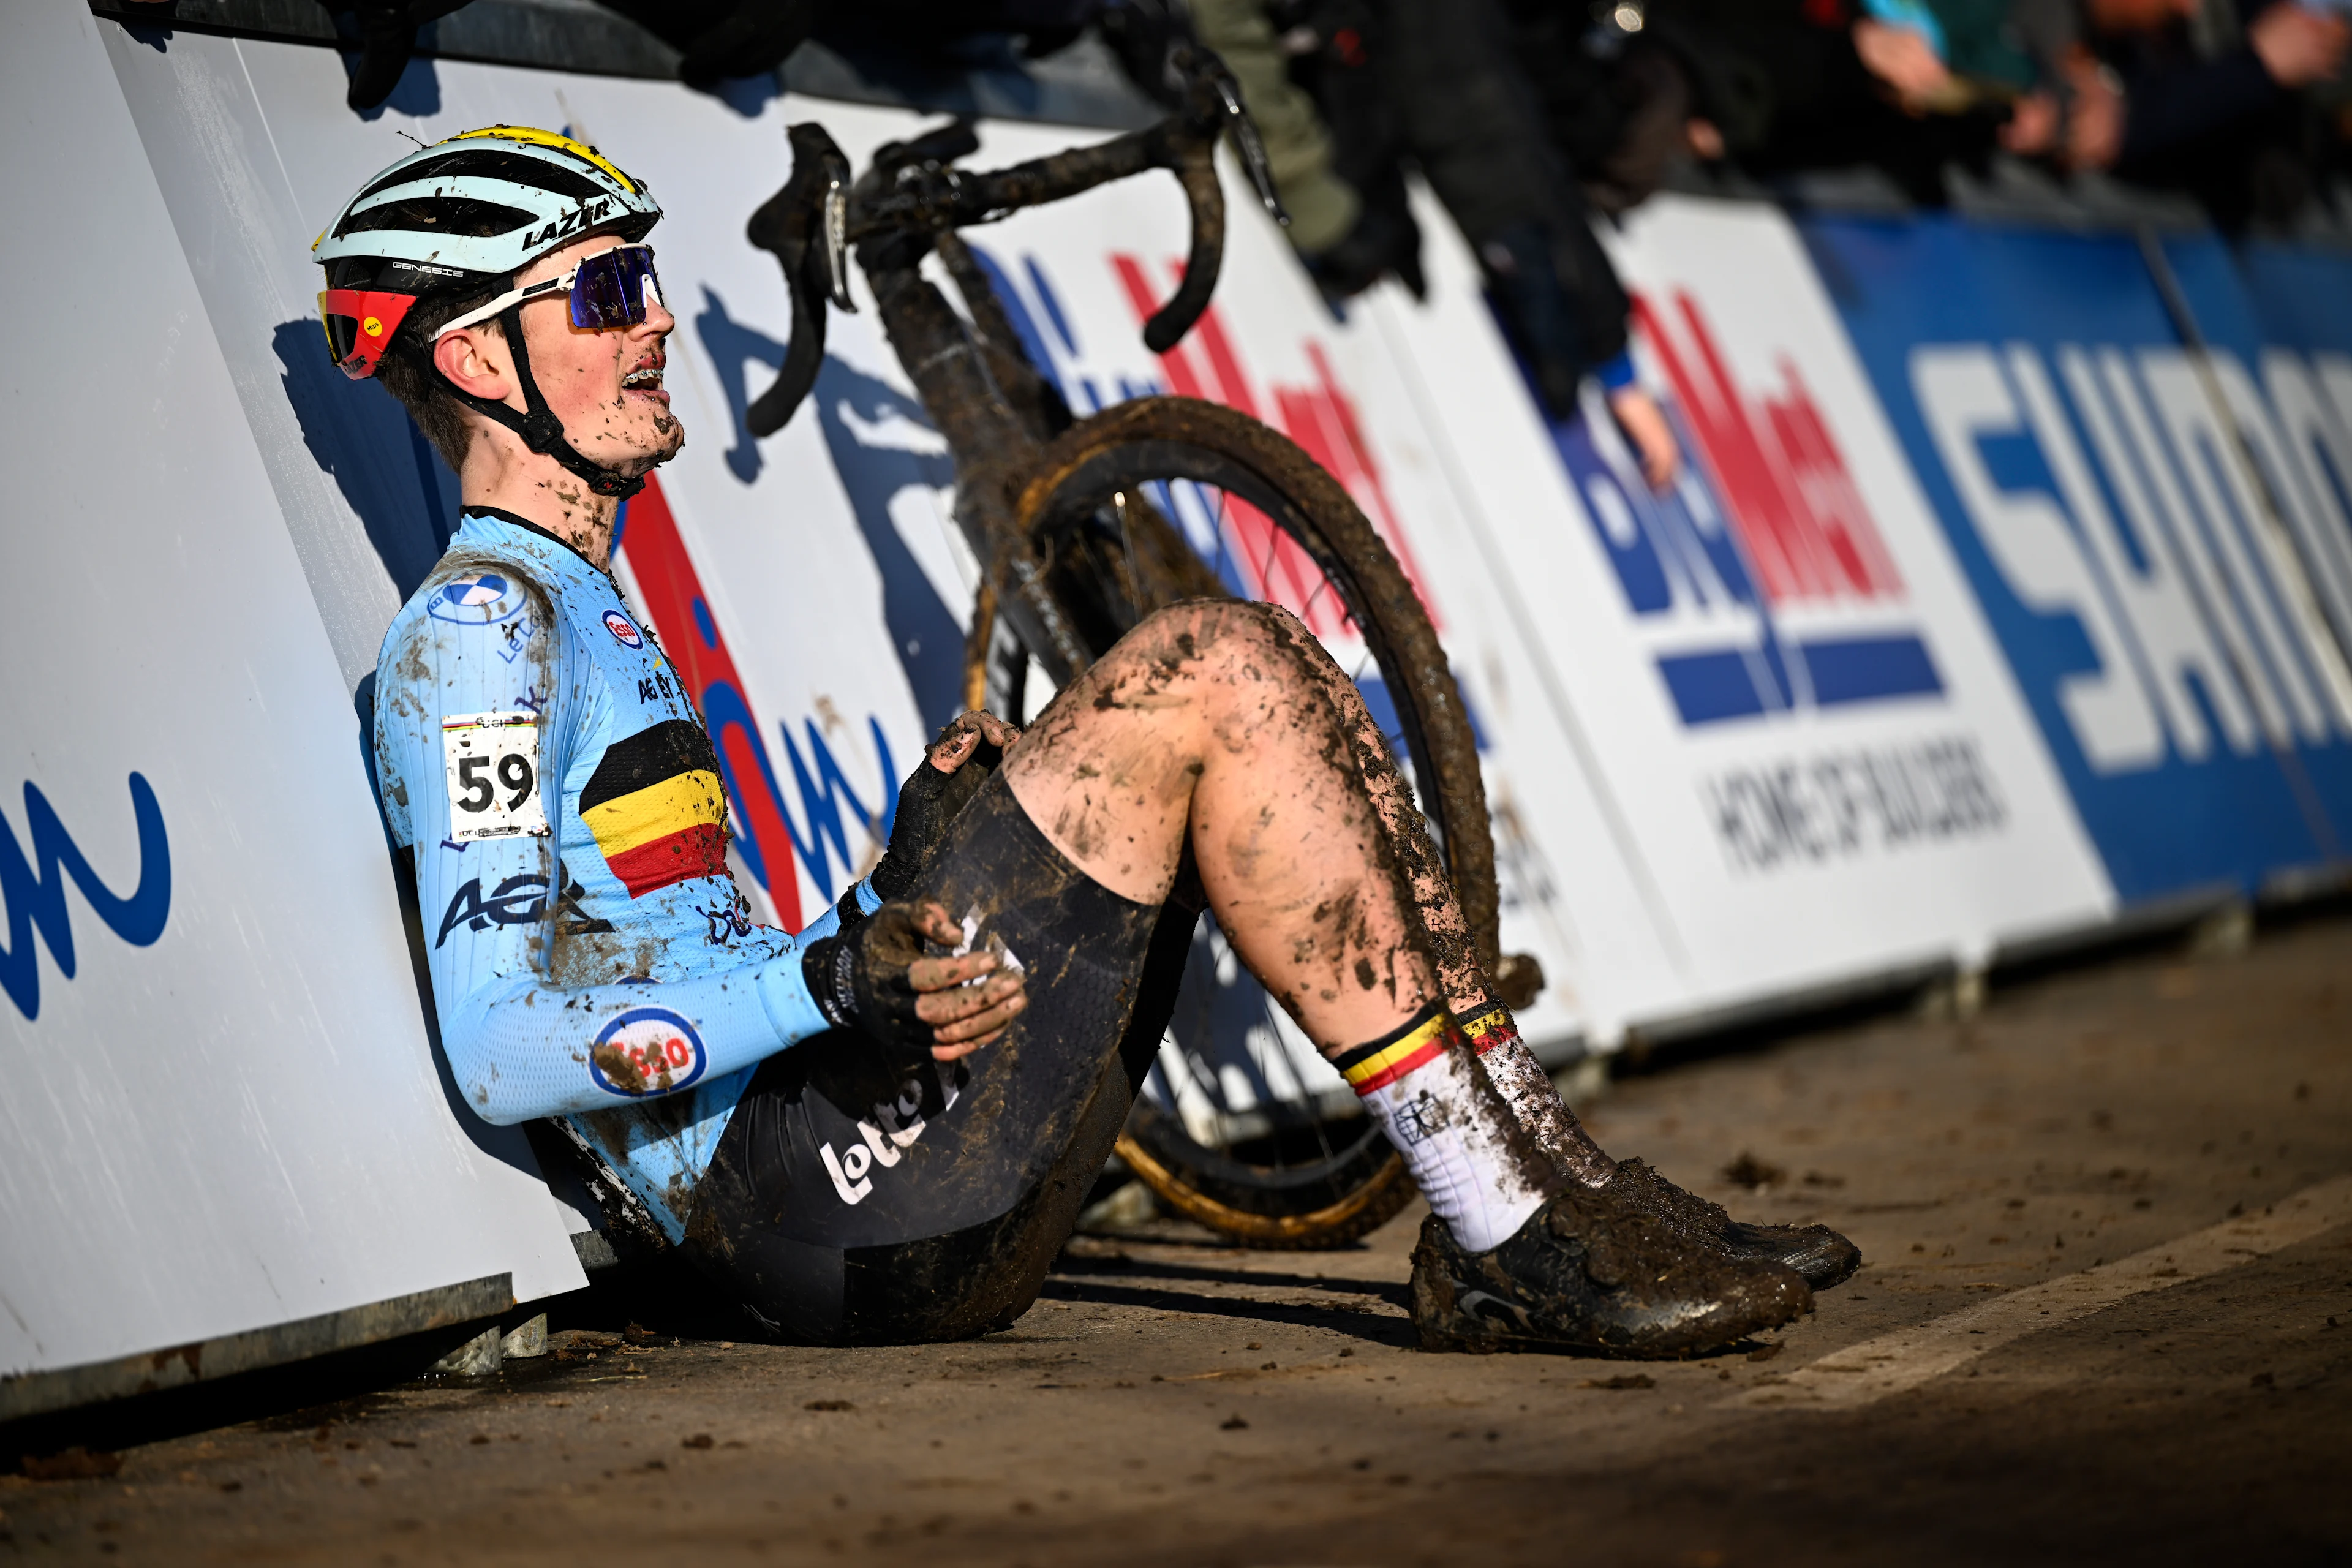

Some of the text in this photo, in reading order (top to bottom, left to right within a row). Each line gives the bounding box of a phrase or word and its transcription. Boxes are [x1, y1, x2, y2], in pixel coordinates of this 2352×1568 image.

[522, 198, 611, 251] LAZER
[392, 261, 464, 277] GENESIS
[367, 322, 379, 331] Mips
[1908, 342, 2352, 775] SHIM
[457, 753, 533, 813] 59
[611, 1038, 690, 1079] sso
